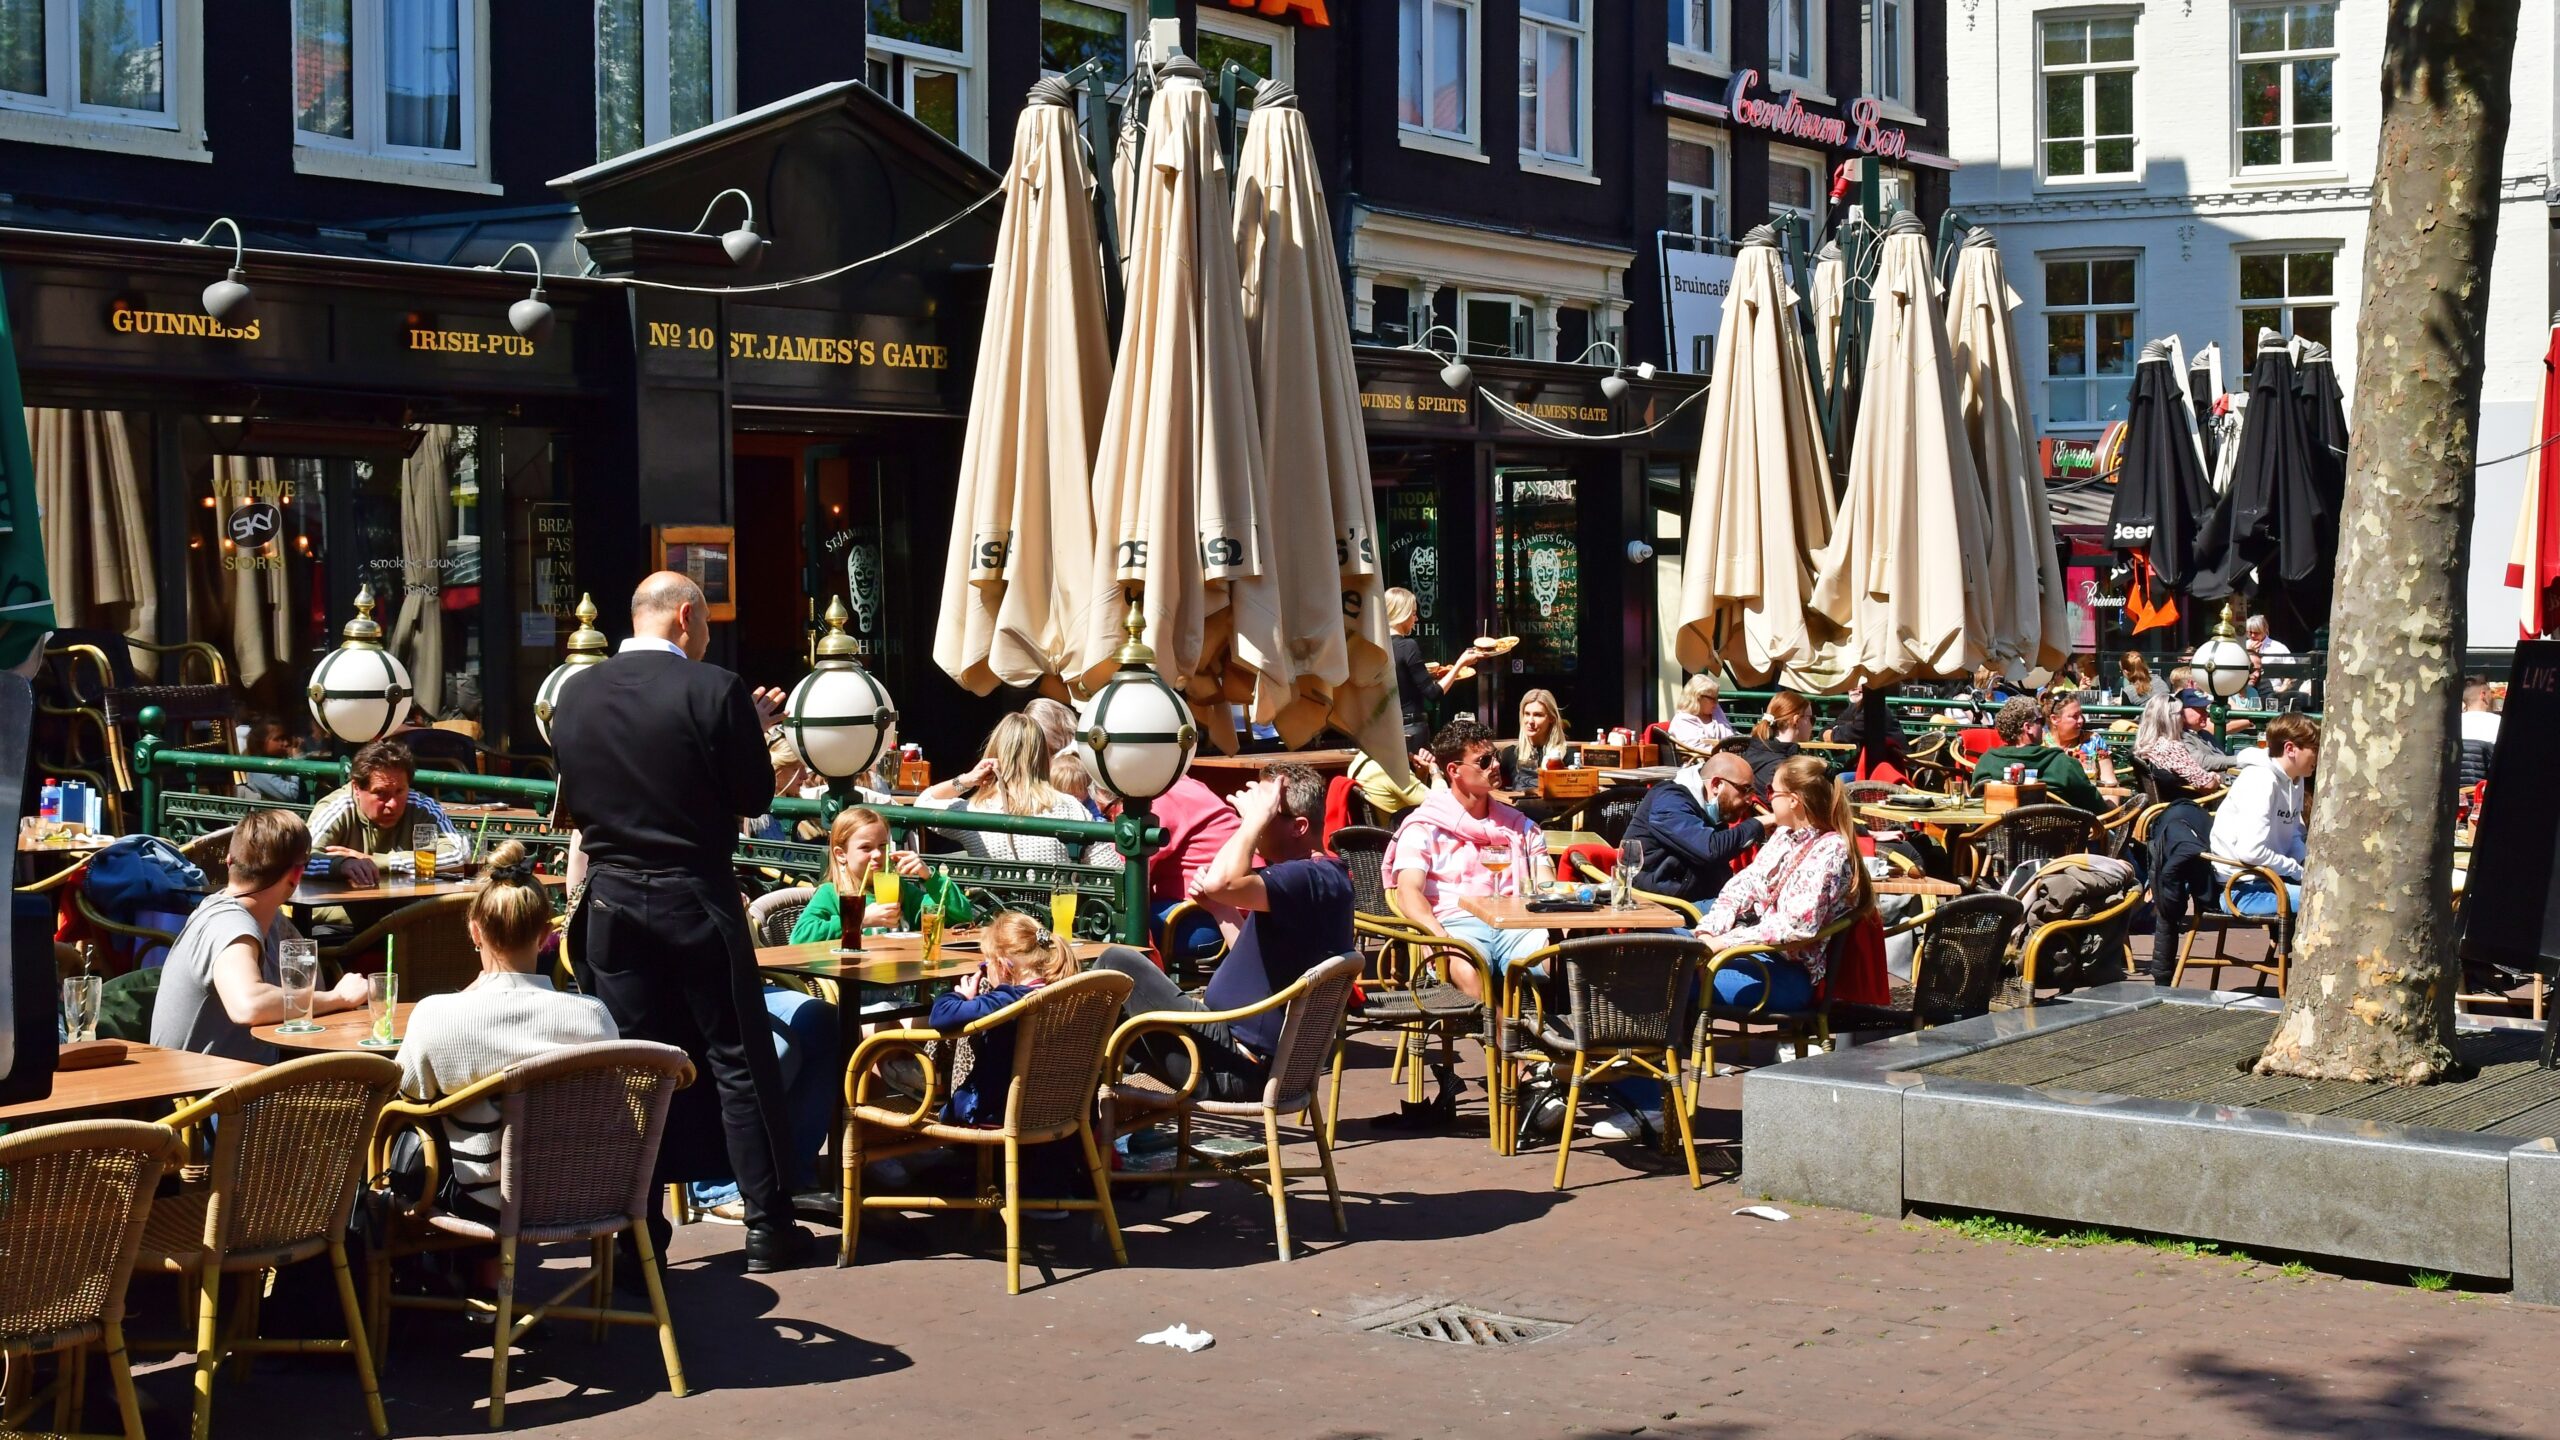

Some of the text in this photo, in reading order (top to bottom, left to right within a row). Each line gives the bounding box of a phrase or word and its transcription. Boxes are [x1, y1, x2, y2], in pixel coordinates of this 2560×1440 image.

[1731, 68, 1907, 159] Centrum Bar
[409, 329, 535, 356] IRISH-PUB
[687, 328, 714, 350] 10
[882, 342, 948, 370] GATE
[1360, 392, 1467, 414] WINES & SPIRITS
[1580, 407, 1609, 422] GATE
[211, 480, 296, 498] WE HAVE
[232, 508, 274, 540] SKY
[547, 537, 574, 552] FAS
[2522, 665, 2556, 692] LIVE
